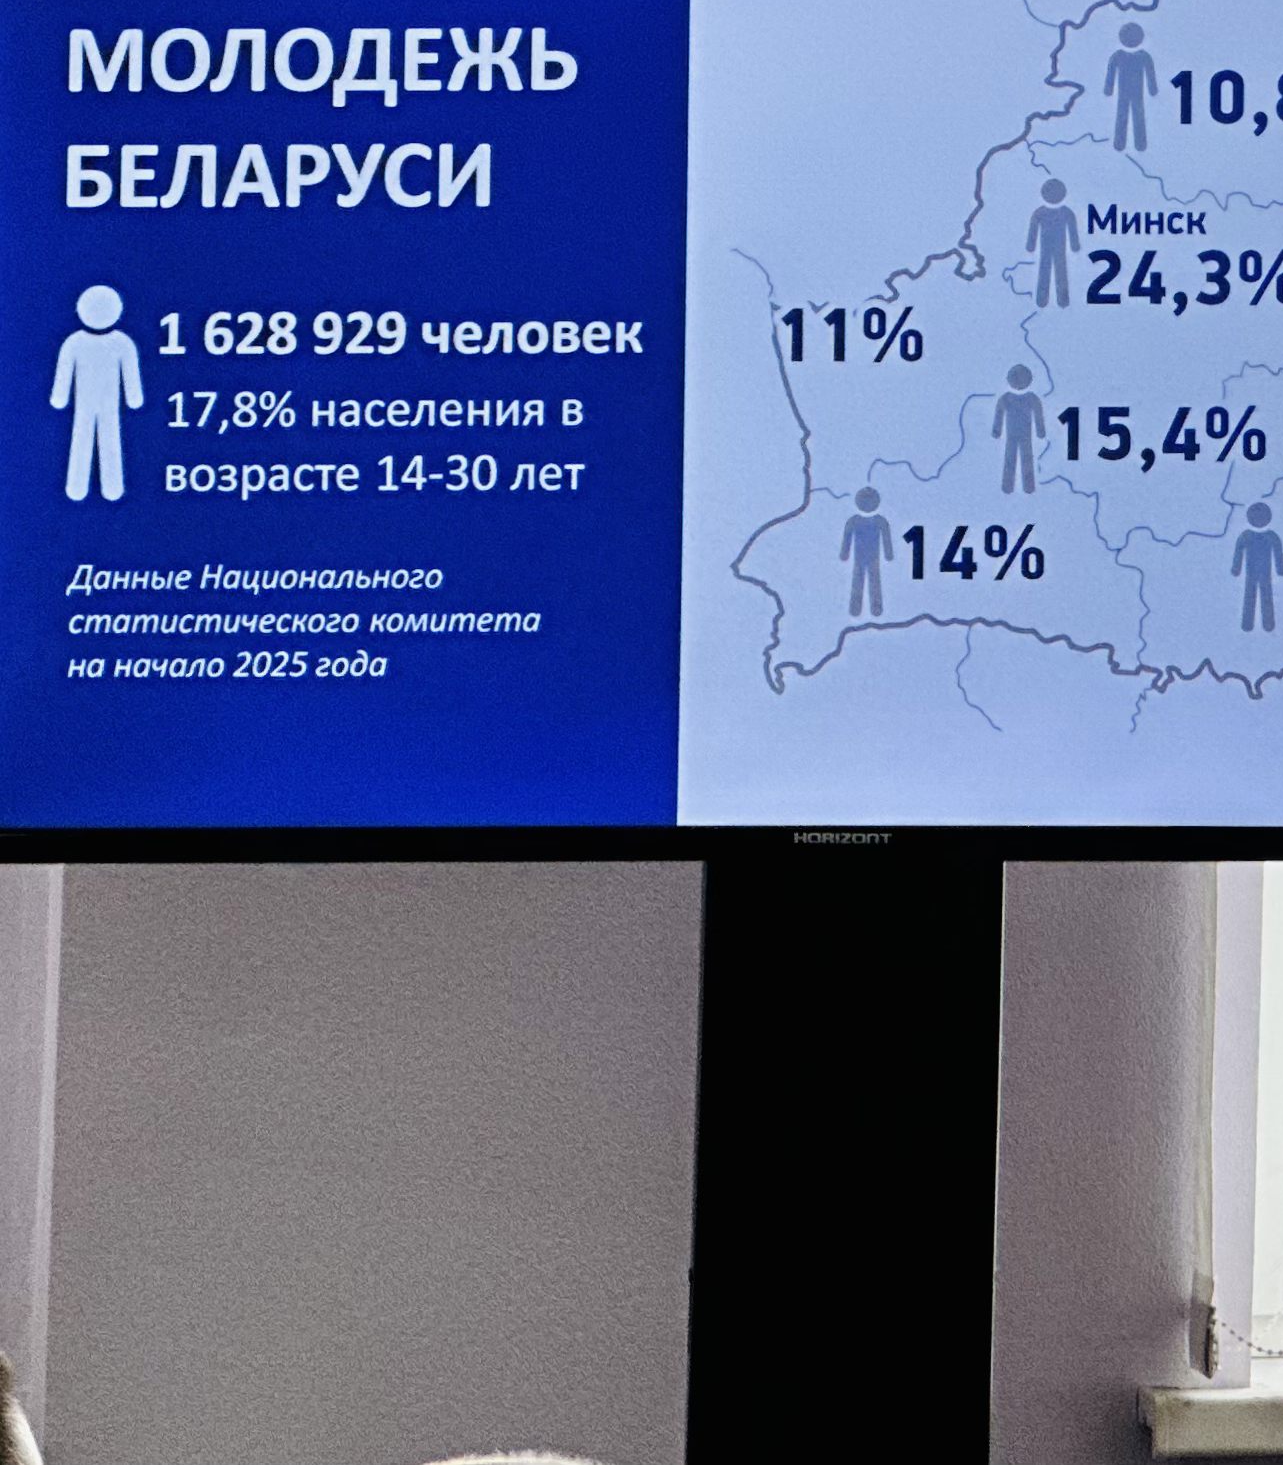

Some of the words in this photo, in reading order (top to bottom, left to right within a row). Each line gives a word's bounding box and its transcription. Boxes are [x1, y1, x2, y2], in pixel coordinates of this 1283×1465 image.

[67, 27, 579, 108] МОЛОДЕЖЬ
[65, 142, 493, 209] БЕЛАРУСИ
[1086, 203, 1208, 236] Минск
[158, 312, 187, 355] 1
[203, 310, 298, 356] 628
[312, 310, 407, 355] 929
[421, 320, 644, 355] человек
[781, 306, 924, 364] 11%
[167, 390, 297, 435] 17,8%
[311, 399, 545, 428] населения
[561, 398, 584, 426] в
[1057, 404, 1267, 474] 15,4%
[165, 463, 360, 501] возрасте
[377, 454, 498, 492] 14-30
[509, 462, 586, 492] лет
[902, 523, 1046, 581] 14%
[66, 564, 193, 597] Данные
[199, 563, 444, 596] Национального
[68, 610, 360, 635] статистического
[369, 609, 542, 633] комитета
[67, 657, 106, 679] на
[113, 657, 225, 679] начало
[232, 650, 309, 679] 2025
[314, 649, 388, 679] года
[793, 832, 892, 844] HORIZONT
